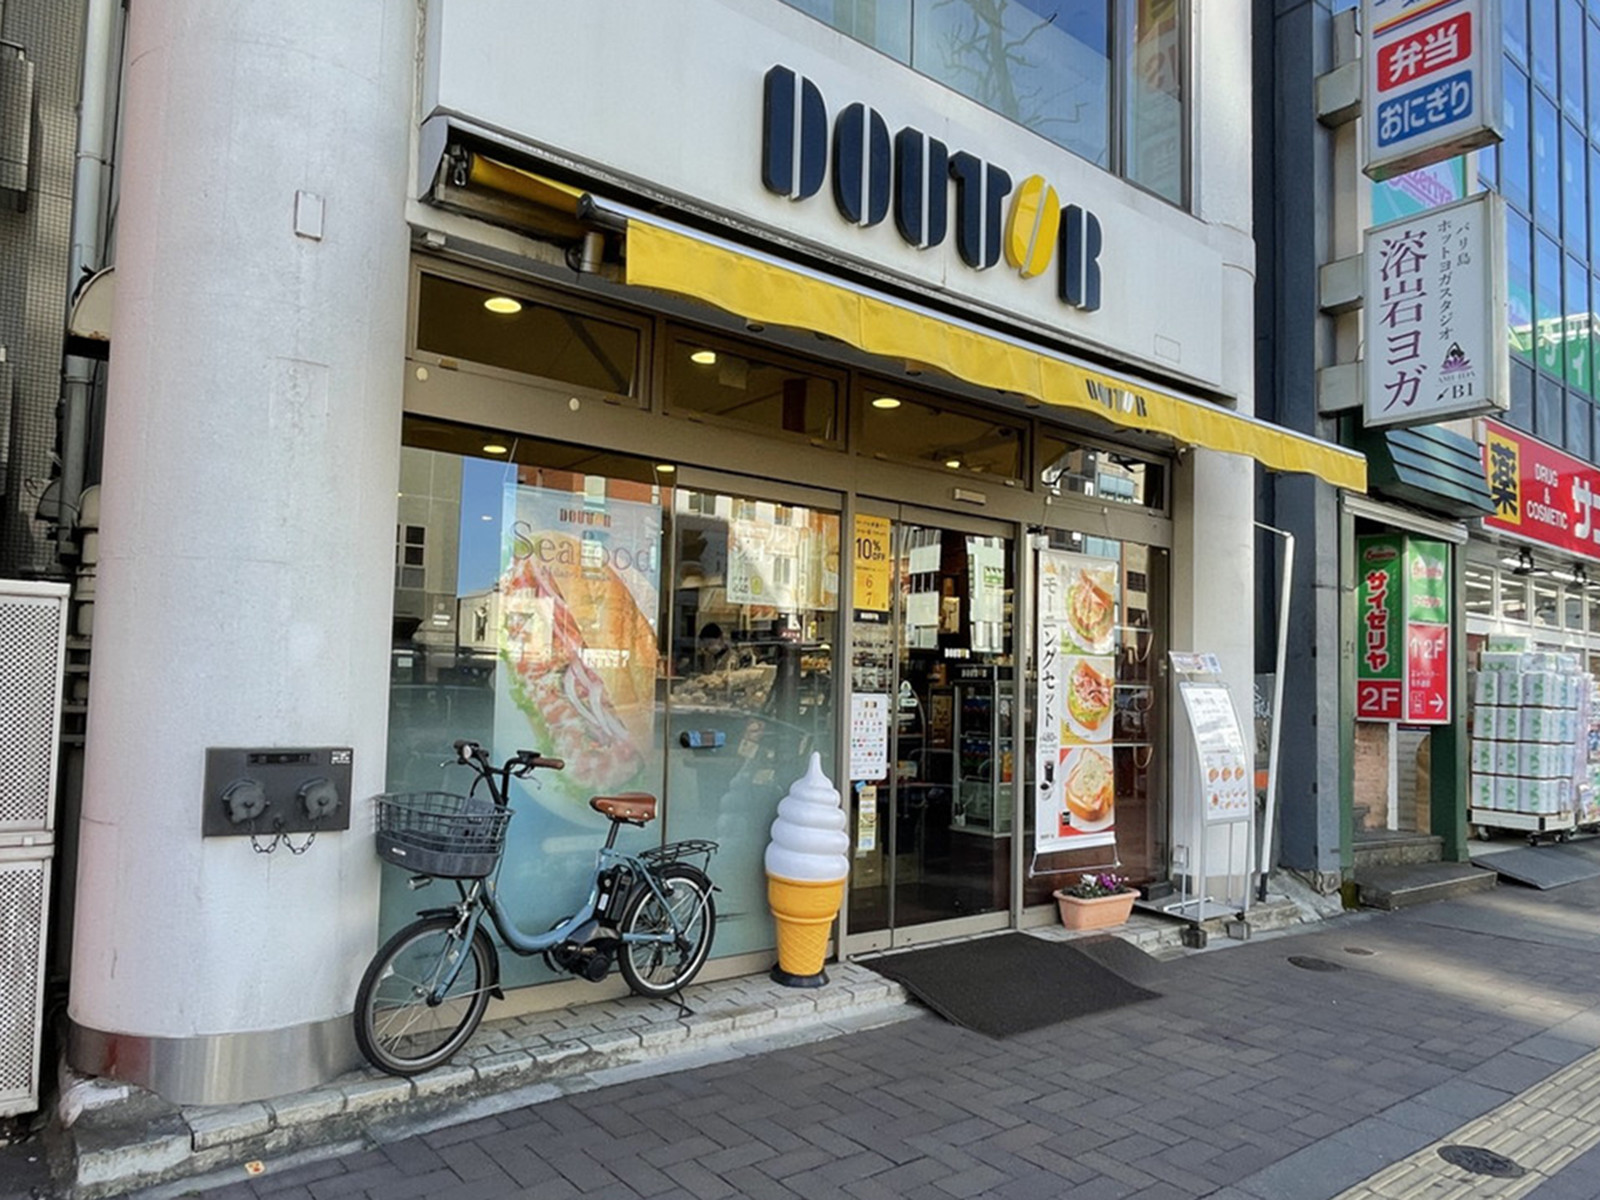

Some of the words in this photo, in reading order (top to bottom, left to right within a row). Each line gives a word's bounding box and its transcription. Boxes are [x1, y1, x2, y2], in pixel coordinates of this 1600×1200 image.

[1388, 23, 1458, 83] 弁当
[1379, 82, 1470, 139] おにぎり
[761, 64, 1102, 313] DOUTOR
[1455, 221, 1472, 267] バリ島
[1438, 219, 1454, 341] ホットヨガスタジオ
[1379, 230, 1428, 412] 溶岩ヨガ
[1452, 382, 1474, 399] B1
[1490, 441, 1517, 517] 薬
[1534, 463, 1558, 488] DRUG
[1543, 487, 1551, 504] &
[559, 508, 612, 528] DOUTOR
[1526, 499, 1569, 530] COSMETIC
[1572, 475, 1600, 546] サ
[510, 520, 657, 573] Seaood
[1365, 570, 1388, 673] サイゼリヤ
[1424, 638, 1445, 660] 2F
[1042, 577, 1058, 727] モーニングセット
[1361, 686, 1399, 712] 2F
